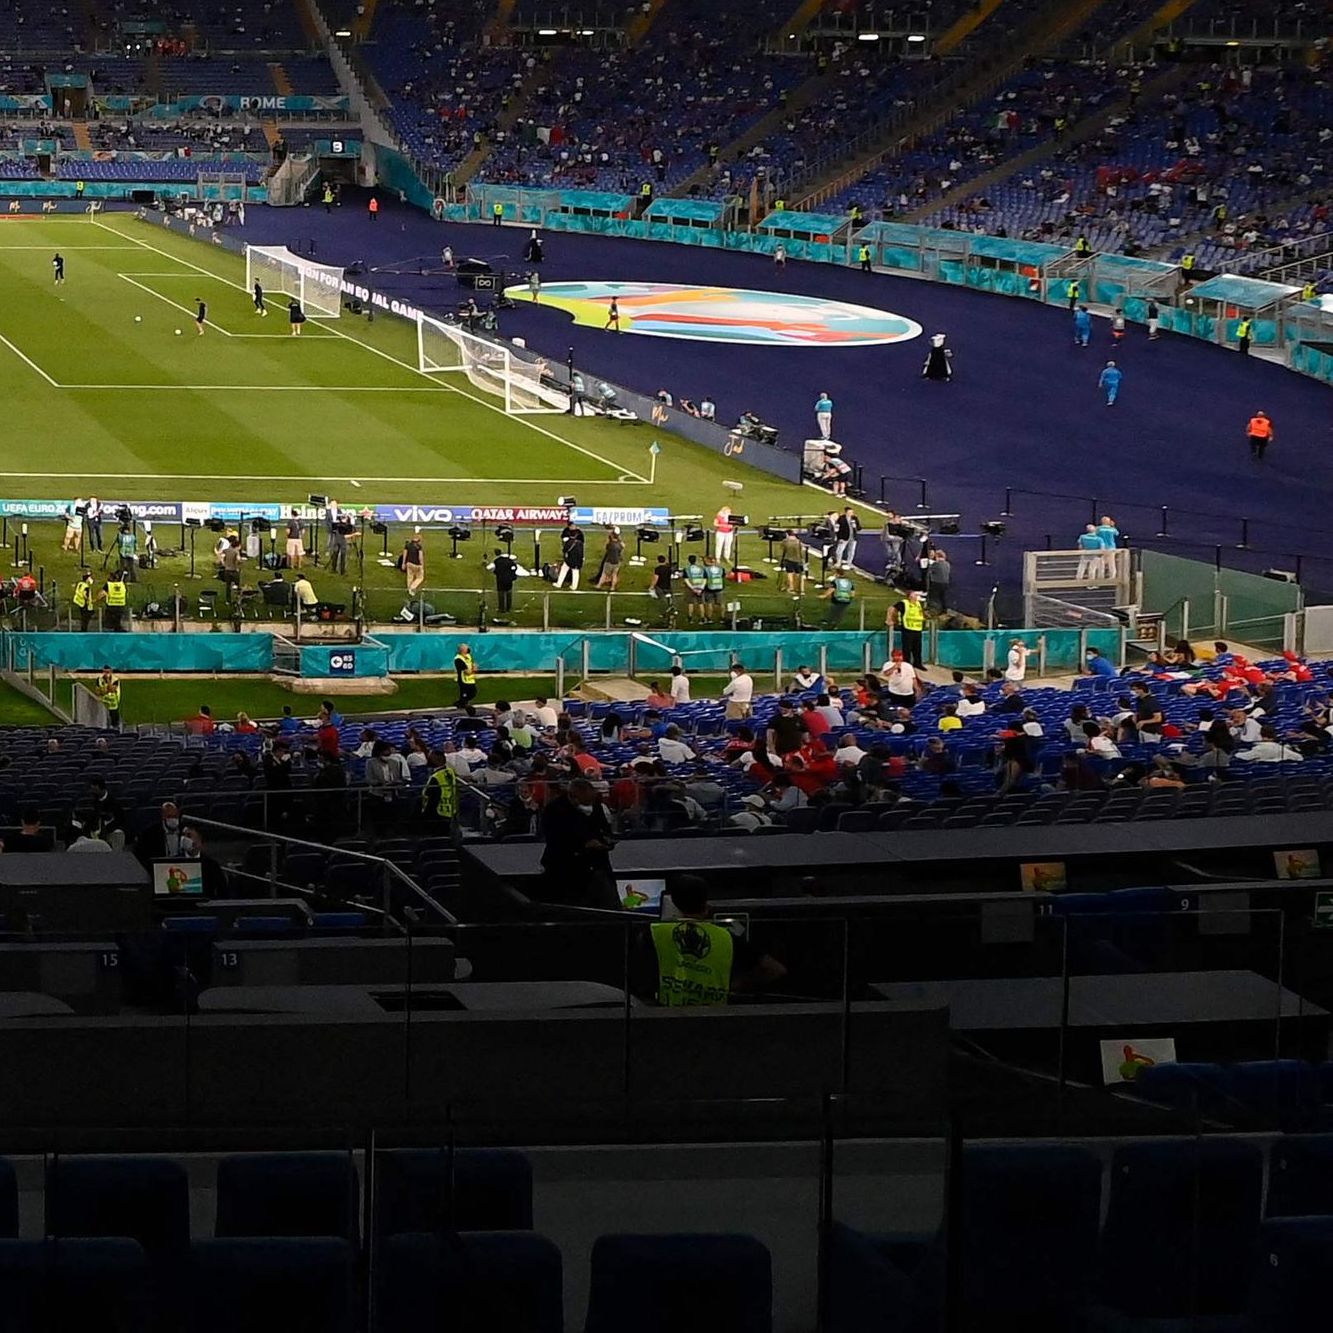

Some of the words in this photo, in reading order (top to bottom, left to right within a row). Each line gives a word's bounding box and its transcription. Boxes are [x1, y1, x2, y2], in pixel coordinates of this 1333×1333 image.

[240, 97, 286, 109] ROME
[332, 141, 343, 153] B
[320, 272, 339, 288] FOR
[340, 280, 354, 295] AN
[2, 502, 29, 513] UEFA
[29, 503, 55, 514] EURO
[394, 507, 453, 522] vivo
[471, 509, 515, 521] QATAR
[516, 509, 569, 522] AIRWAYS
[596, 511, 644, 524] GAZPROM
[1038, 903, 1053, 915] 11
[1180, 898, 1190, 911] 9
[102, 954, 118, 967] 15
[221, 953, 237, 966] 13
